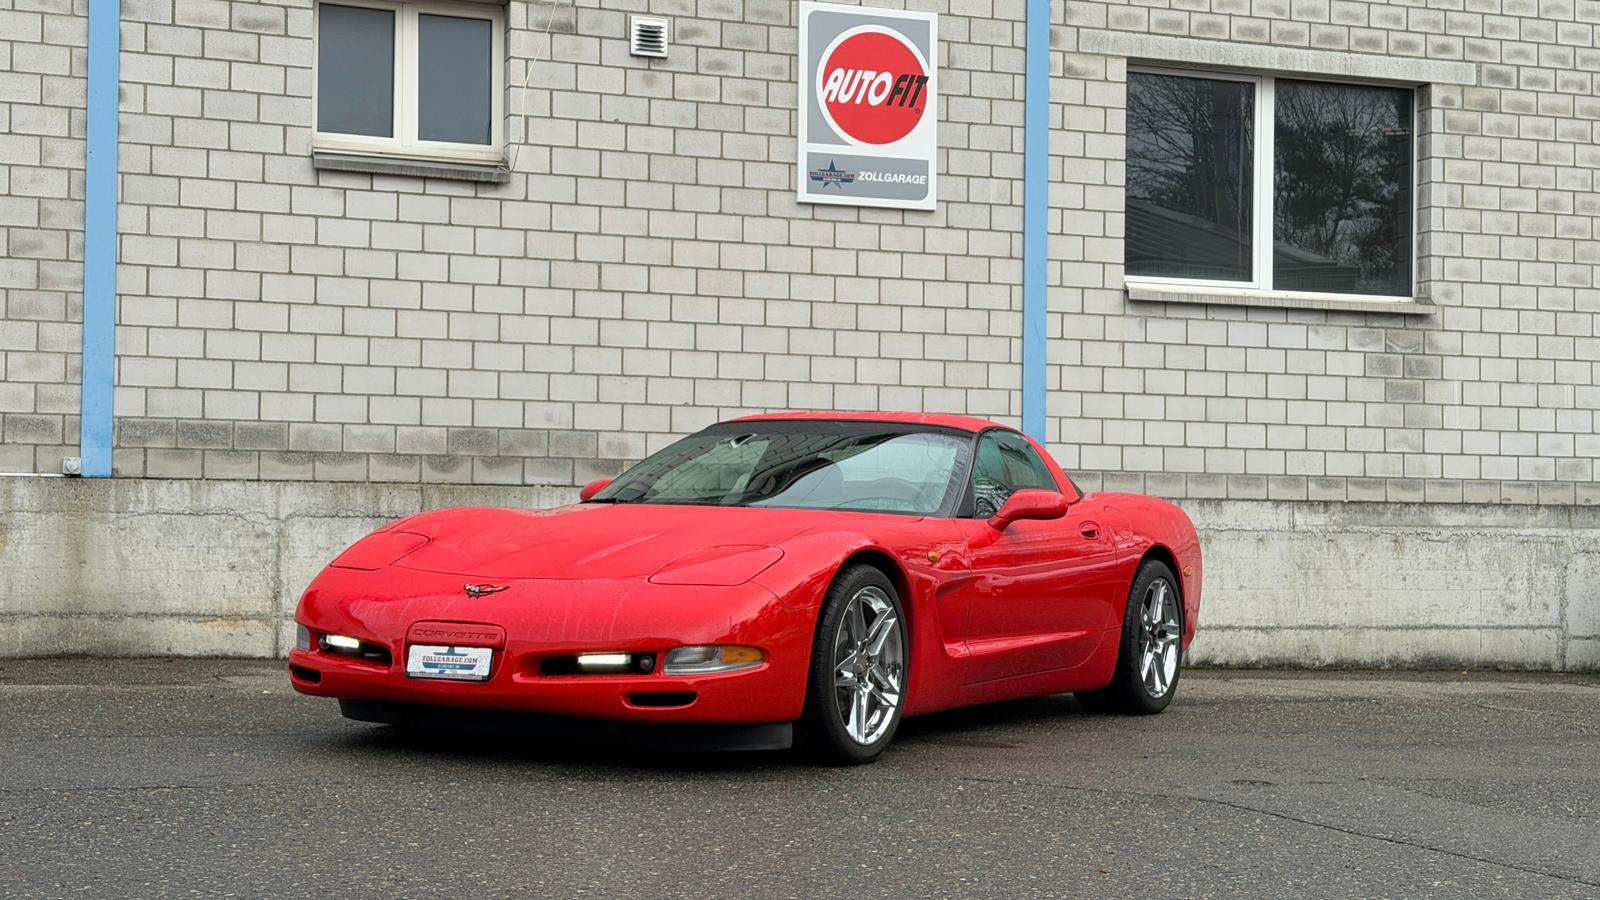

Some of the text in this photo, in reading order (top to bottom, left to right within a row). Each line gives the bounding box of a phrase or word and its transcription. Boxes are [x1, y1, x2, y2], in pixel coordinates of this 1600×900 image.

[823, 67, 929, 108] AUTOFIT
[858, 171, 926, 184] ZOLLGARAGE
[413, 629, 498, 640] CORVETTE
[422, 655, 478, 664] ZOLLGARAGE.COM
